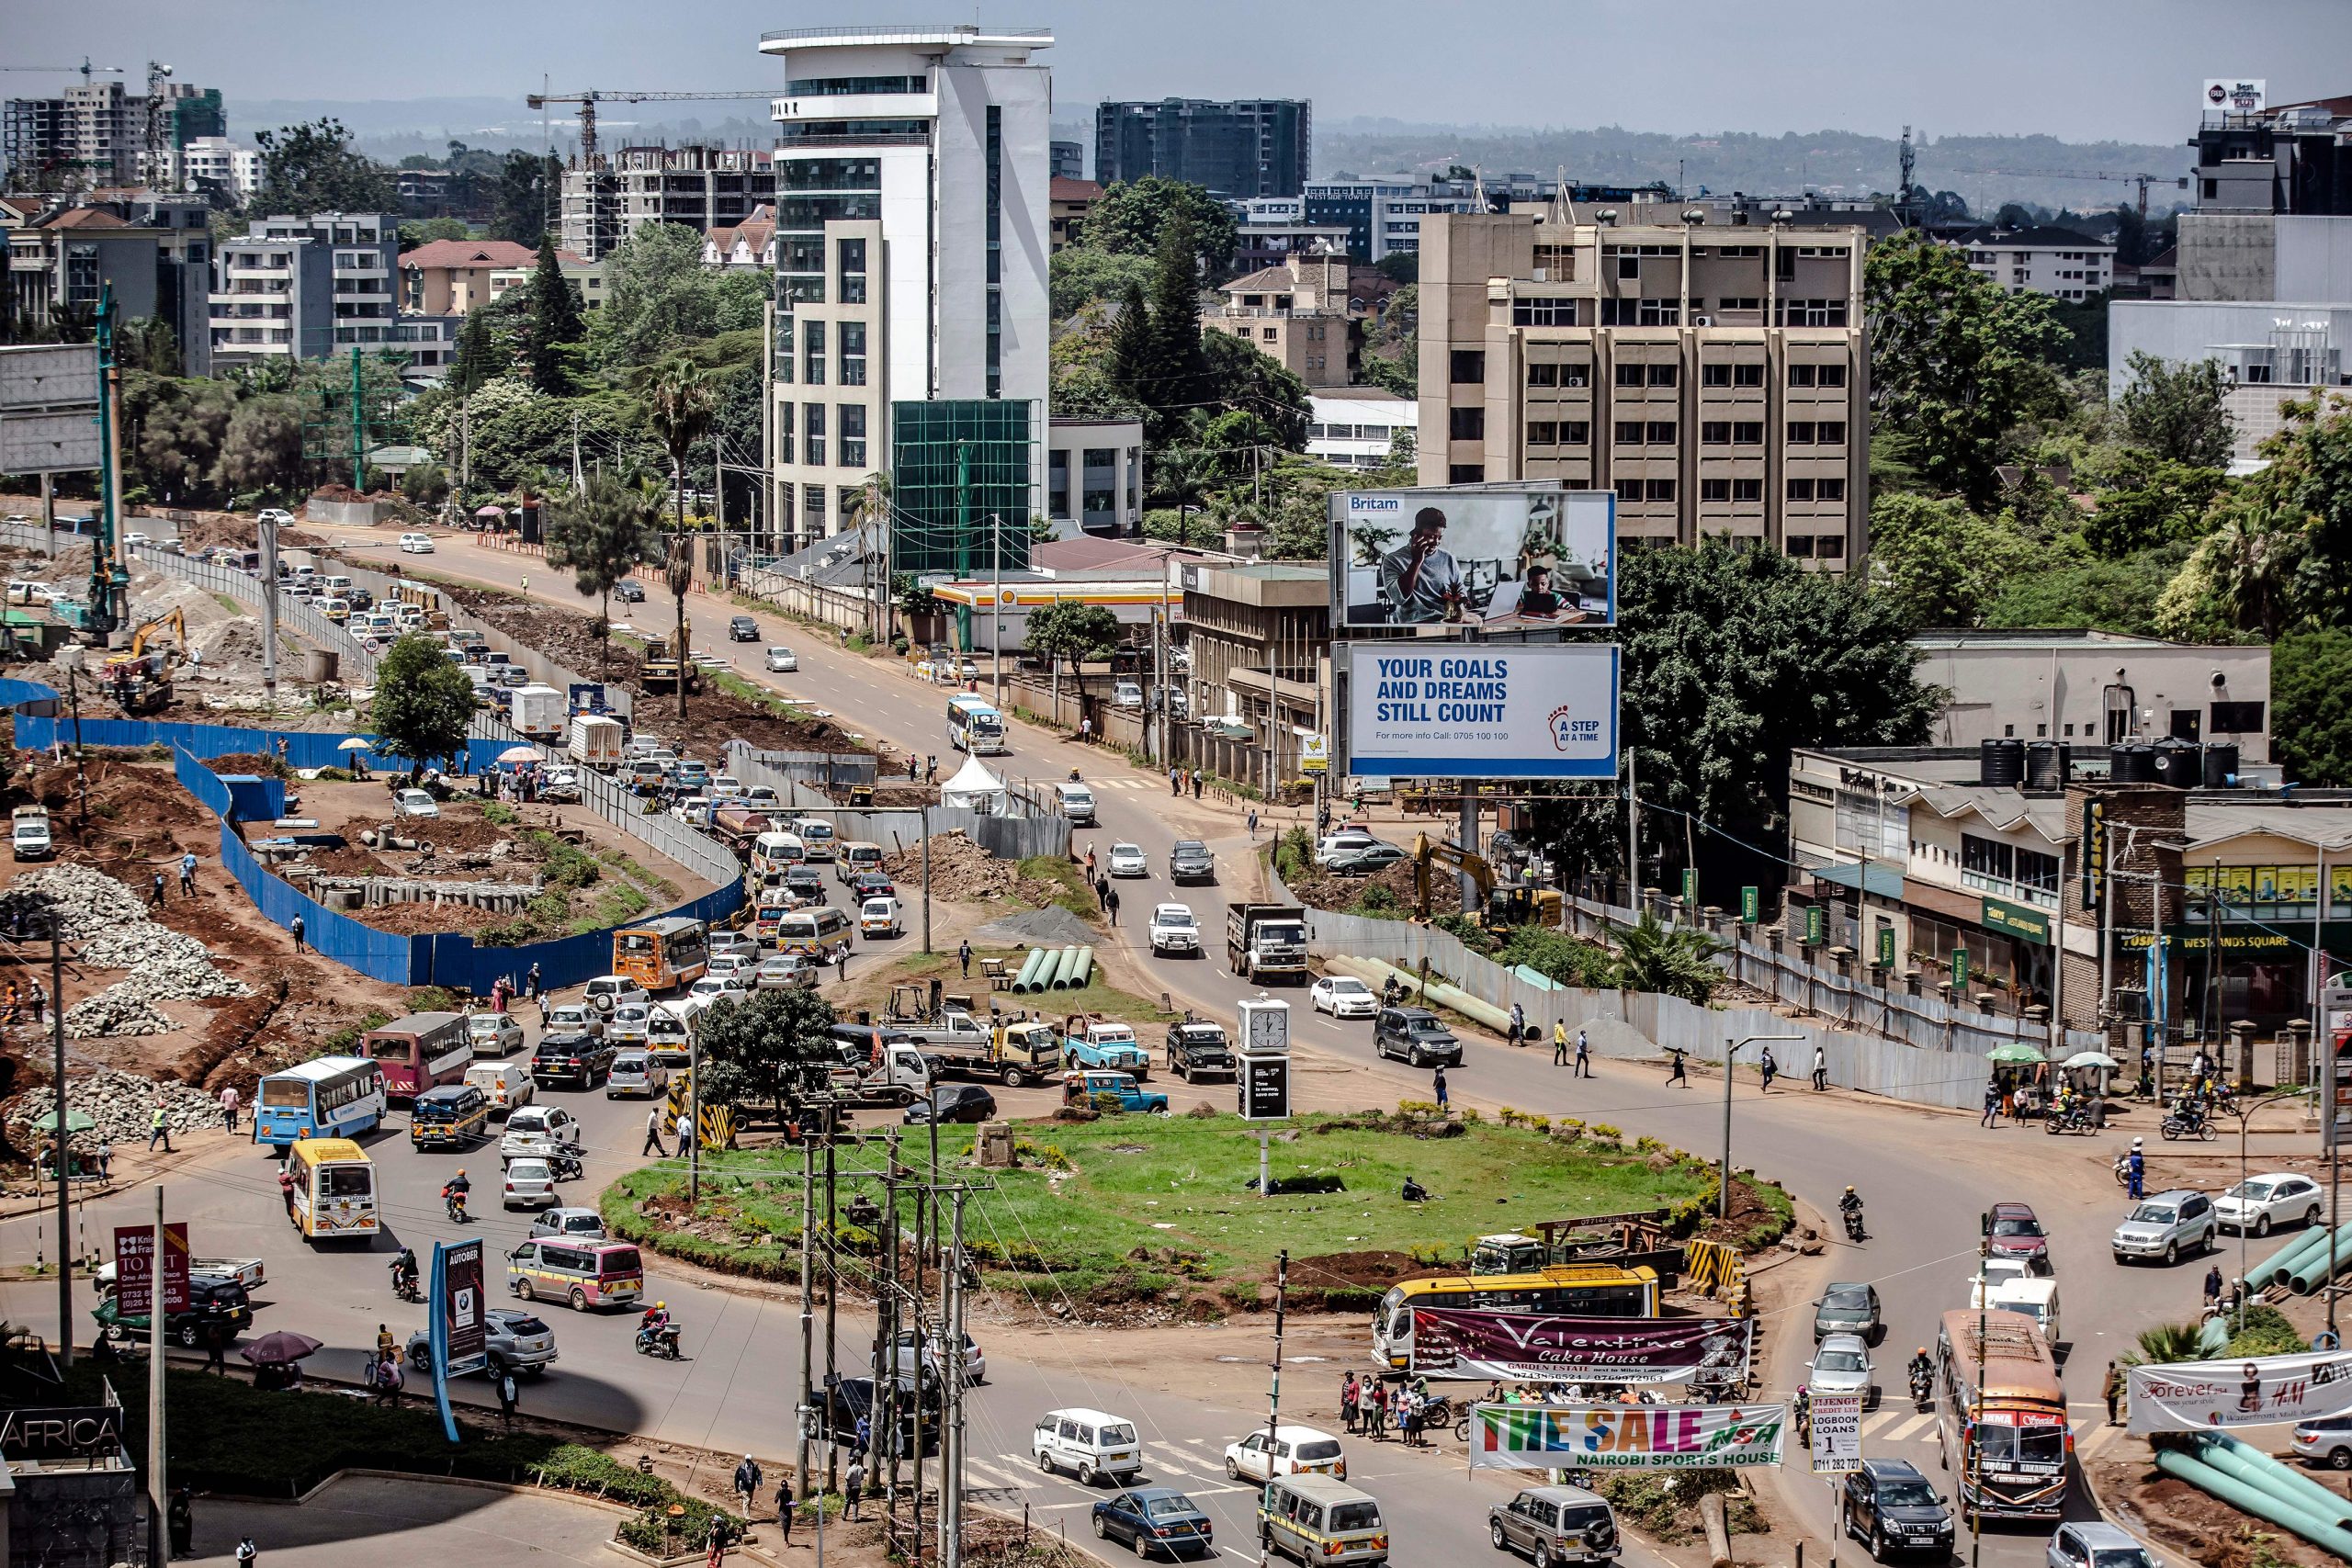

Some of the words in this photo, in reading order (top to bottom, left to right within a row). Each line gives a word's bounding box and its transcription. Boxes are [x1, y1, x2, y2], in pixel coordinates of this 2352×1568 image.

[1351, 497, 1398, 509] Britam
[1377, 659, 1432, 678] YOUR
[1440, 659, 1507, 678] GOALS
[1377, 681, 1418, 699] AND
[1425, 682, 1507, 700] DREAMS
[1377, 703, 1431, 722] STILL
[1438, 703, 1505, 722] COUNT
[1560, 721, 1568, 731] A
[1571, 721, 1599, 731] STEP
[1452, 852, 1461, 863] CAT
[2184, 938, 2245, 948] WESTANDS
[2248, 936, 2289, 948] SQUARE
[120, 1257, 144, 1271] TO
[449, 1250, 478, 1265] AUTOBER
[1496, 1316, 1686, 1349] Valentine
[1538, 1351, 1582, 1363] Cake
[1590, 1351, 1648, 1364] House
[1553, 1363, 1590, 1372] ESTATE
[2140, 1381, 2214, 1398] Forever
[2271, 1381, 2306, 1407] H&M
[1813, 1397, 1859, 1406] JIJENGE
[2023, 1415, 2057, 1429] Special
[2226, 1413, 2276, 1421] Waterfront
[1, 1416, 119, 1448] AFRICA
[1477, 1408, 1570, 1452] THE
[1584, 1408, 1702, 1452] SALE
[1825, 1436, 1834, 1452] 1
[73, 1446, 120, 1456] PLACE
[1576, 1455, 1645, 1465] NAIROBI
[1652, 1454, 1718, 1465] SPORTS
[1723, 1452, 1780, 1465] HOUSE
[1813, 1459, 1829, 1470] 0711
[1832, 1459, 1844, 1470] 282
[1847, 1459, 1859, 1469] 727
[2020, 1464, 2059, 1474] KAKAMEGA
